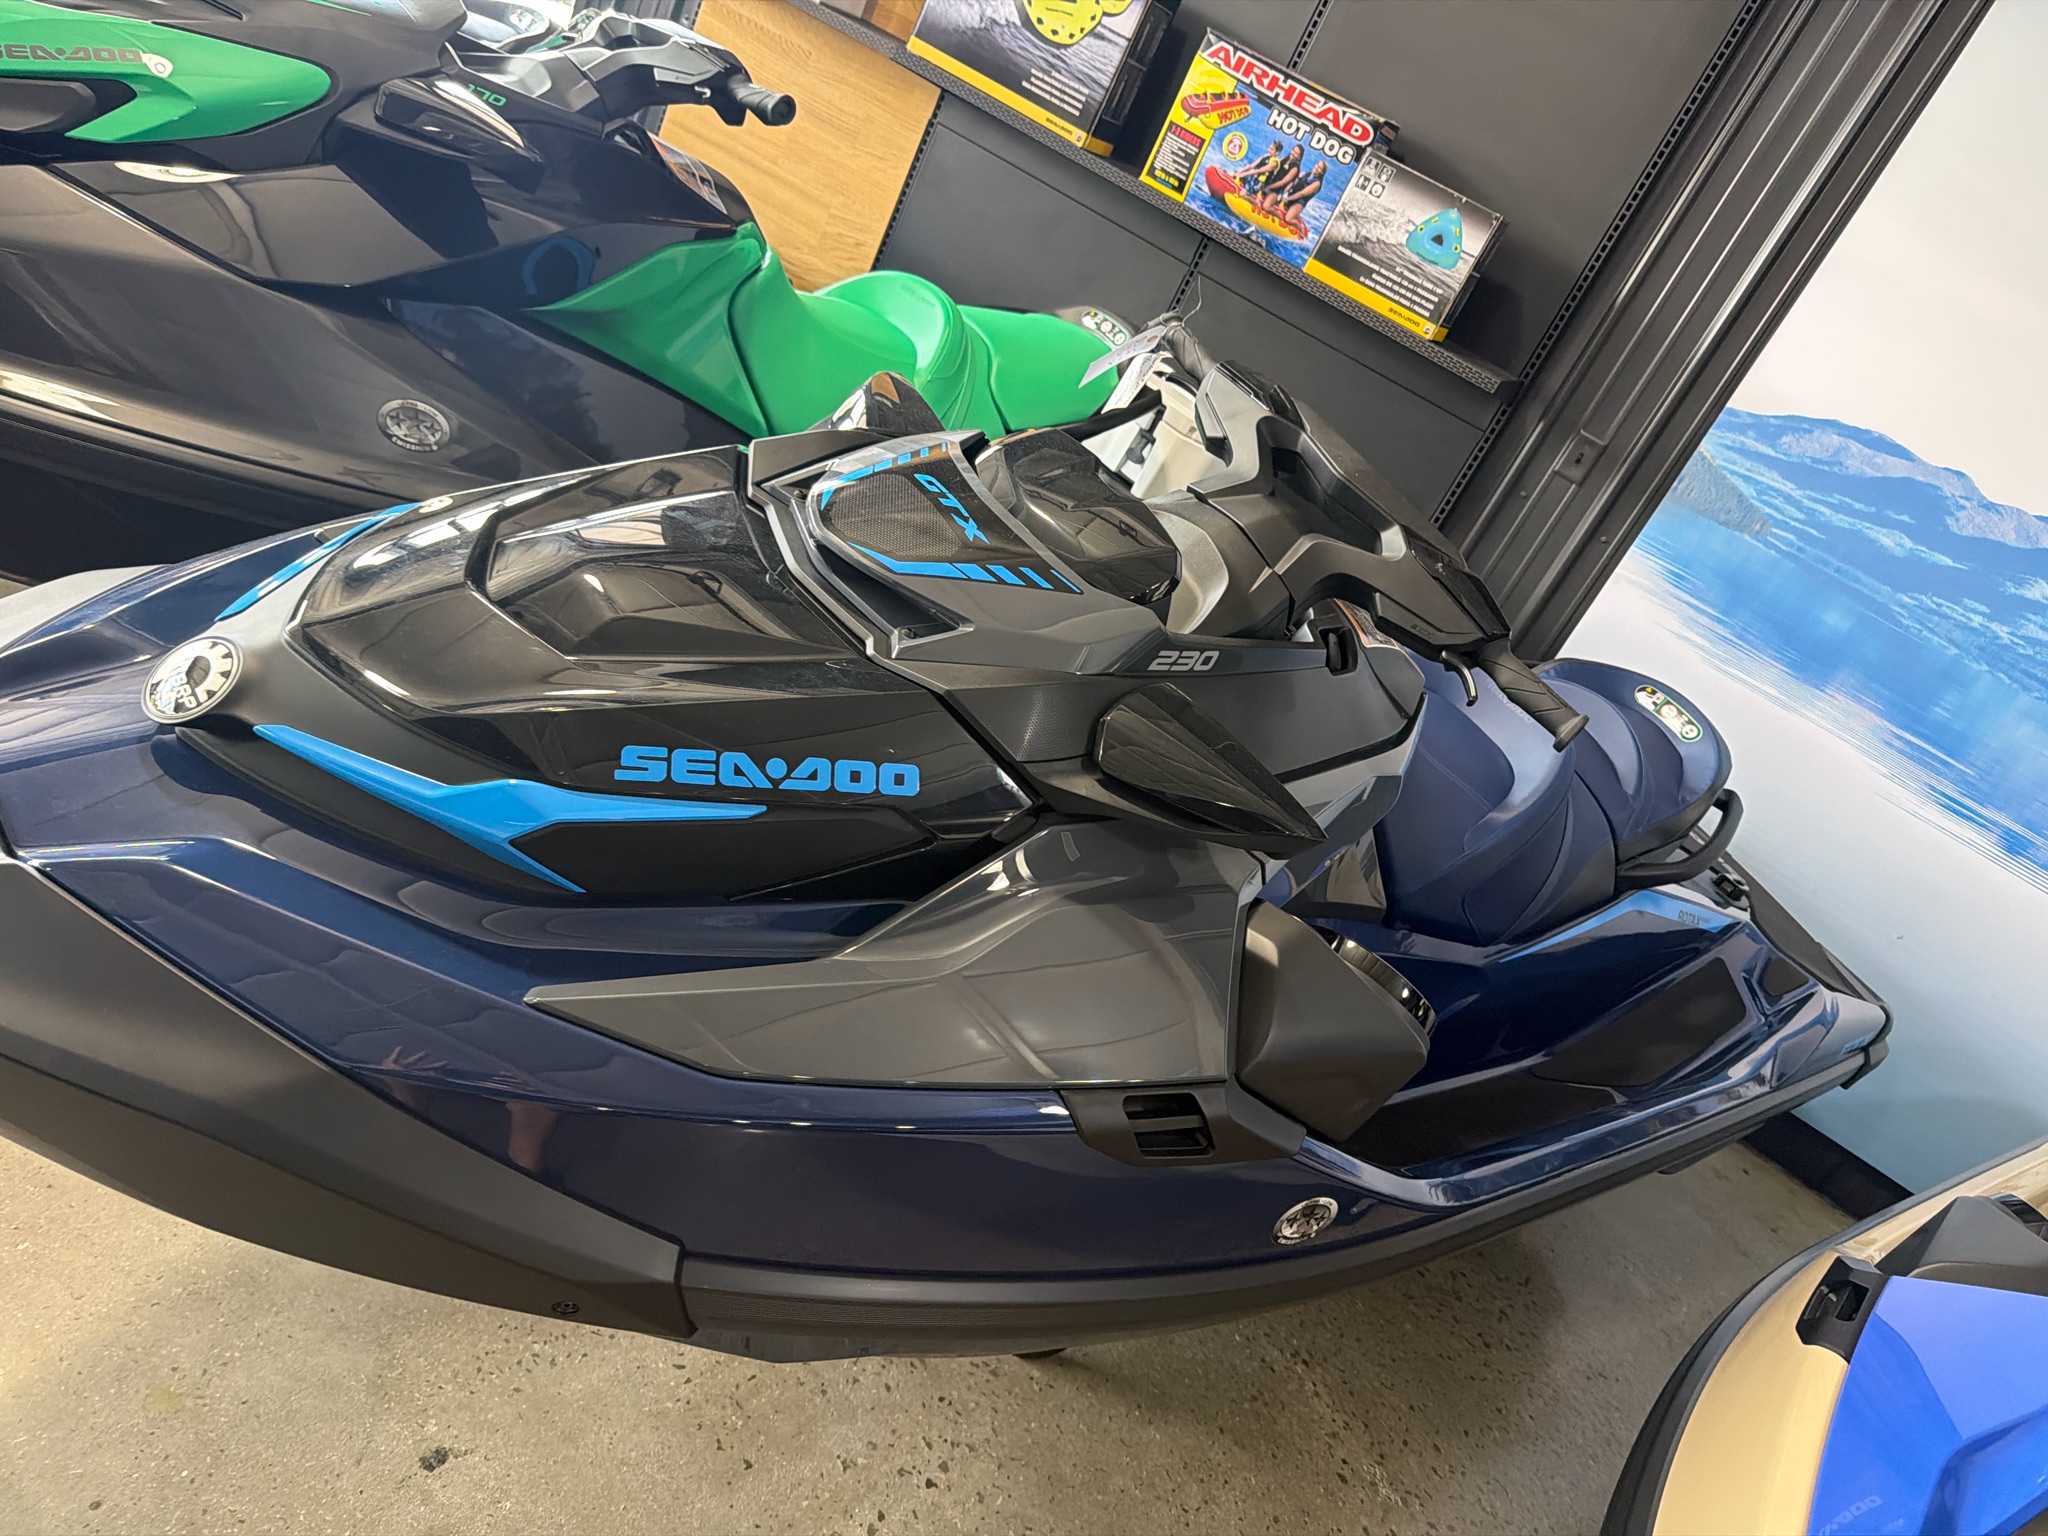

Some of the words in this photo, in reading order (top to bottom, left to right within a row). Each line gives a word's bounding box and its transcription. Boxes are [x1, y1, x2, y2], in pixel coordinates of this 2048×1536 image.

[1204, 41, 1374, 146] AIRHEAD
[1267, 108, 1311, 141] HOT
[1309, 130, 1357, 165] DOG
[914, 473, 991, 545] GTX
[1147, 650, 1220, 671] 230
